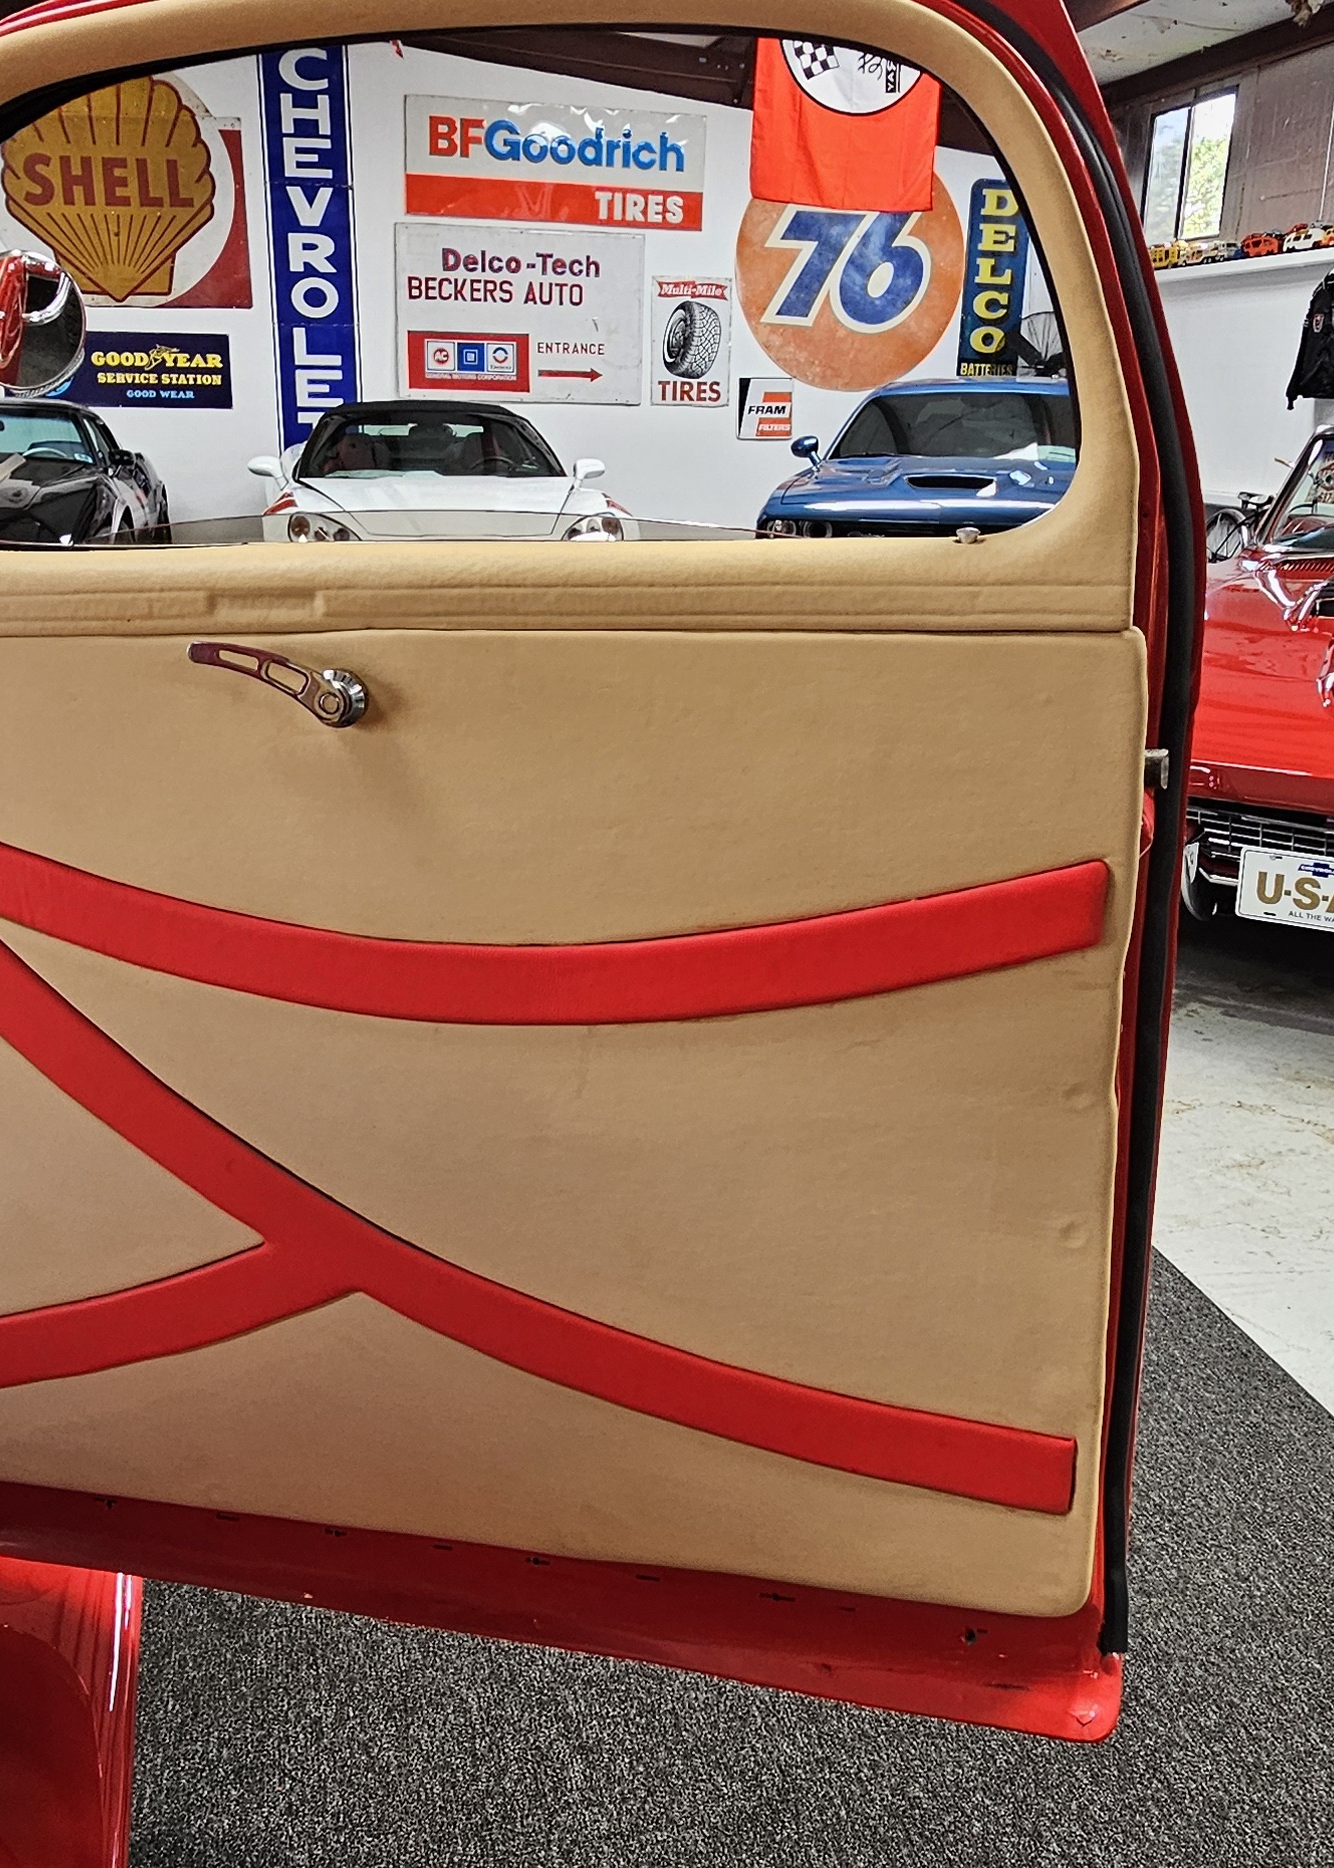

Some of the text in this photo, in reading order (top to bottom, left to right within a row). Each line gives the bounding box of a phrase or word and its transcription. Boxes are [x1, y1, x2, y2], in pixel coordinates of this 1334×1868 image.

[427, 114, 685, 173] BFGoodrich
[22, 151, 195, 209] SHELL
[594, 190, 685, 224] TIRES
[759, 204, 932, 333] 76
[969, 188, 1019, 354] DELCO
[408, 276, 583, 306] BECKERS AUTO
[660, 282, 723, 297] Multi-Mile
[537, 341, 605, 356] ENTRANCE
[434, 351, 449, 362] AC
[960, 362, 1014, 376] BATTERIES
[97, 372, 222, 386] SERVICE STATION
[126, 389, 195, 399] GOOD WEAR
[658, 380, 721, 402] TIRES
[748, 405, 786, 415] FRAM
[1288, 910, 1304, 919] ALL
[1306, 912, 1322, 921] THE
